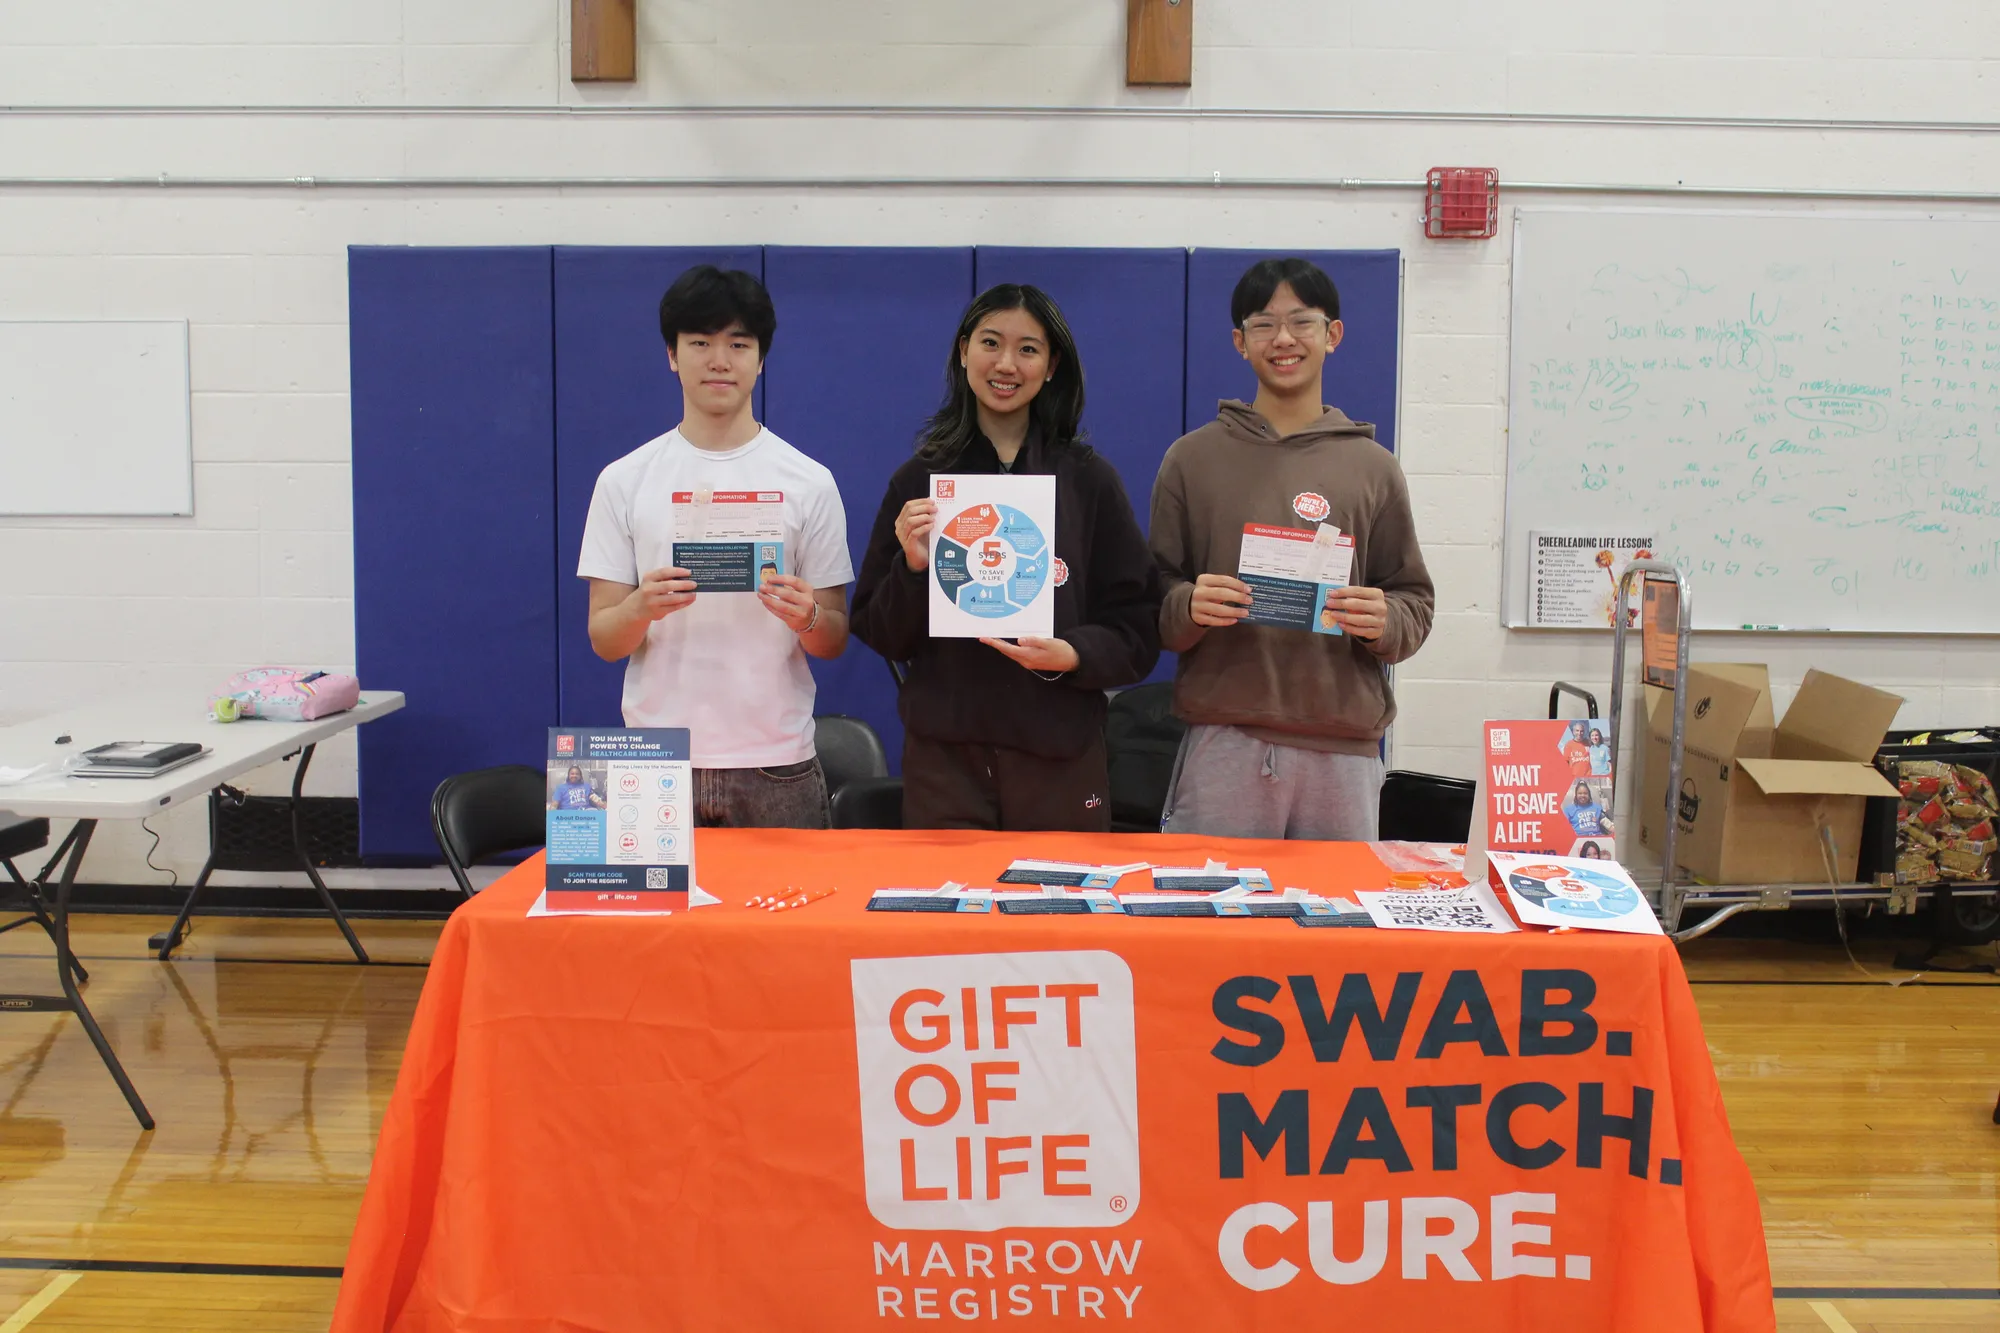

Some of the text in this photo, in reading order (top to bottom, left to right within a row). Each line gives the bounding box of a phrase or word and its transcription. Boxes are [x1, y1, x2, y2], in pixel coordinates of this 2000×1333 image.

[1297, 502, 1324, 515] HERO!
[1301, 496, 1320, 505] YOU'RE
[1254, 527, 1316, 540] REQUIRED INFORMATIO
[1538, 536, 1653, 548] CHEERLEADING LIFE LESSONS
[981, 541, 1002, 568] 5
[1492, 765, 1541, 787] WANT
[1493, 793, 1559, 815] TO SAVE
[1494, 821, 1542, 843] A LIFE
[888, 982, 1100, 1056] GIFT
[1210, 968, 1633, 1068] SWAB.
[894, 1061, 1020, 1127] OF
[1217, 1081, 1683, 1186] MATCH.
[899, 1133, 1092, 1202] LIFE
[1218, 1191, 1592, 1292] CURE.
[873, 1239, 1143, 1279] MARROW
[876, 1284, 1143, 1321] REGISTRY
